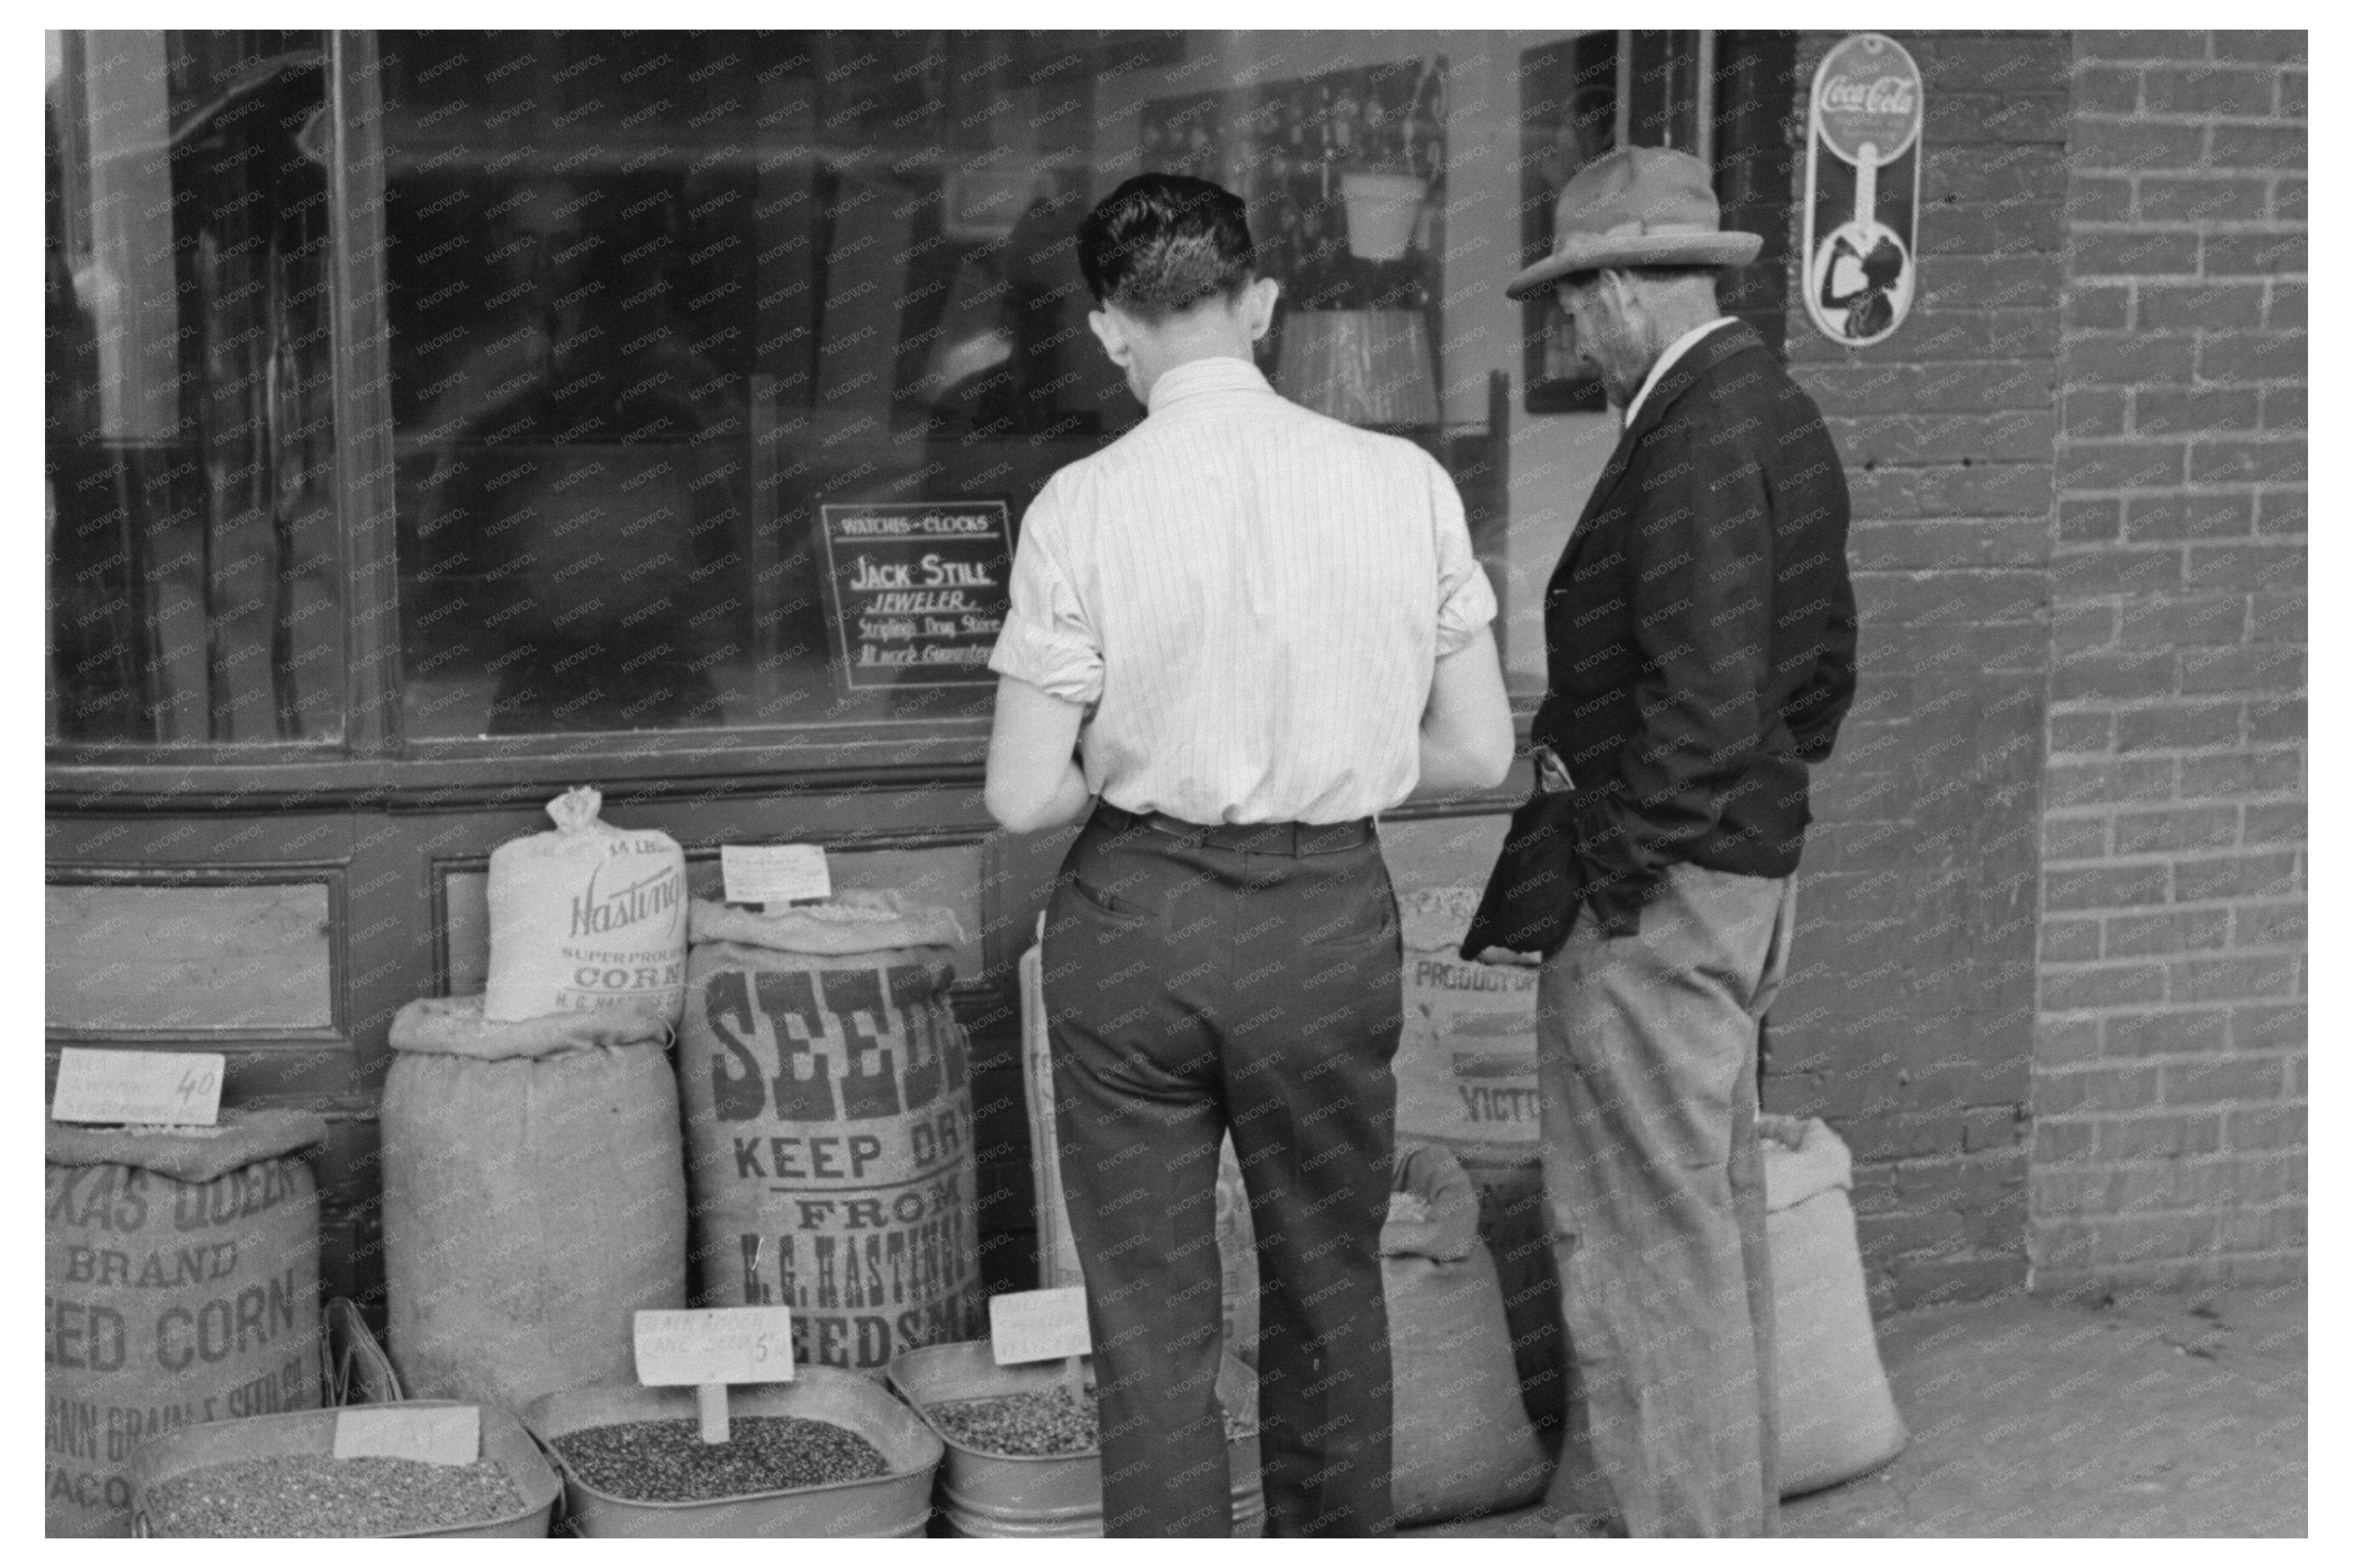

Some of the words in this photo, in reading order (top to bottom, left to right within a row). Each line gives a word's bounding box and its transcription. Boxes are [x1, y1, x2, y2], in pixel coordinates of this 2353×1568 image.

[962, 615, 1001, 632] Store
[574, 963, 680, 989] CORN
[1416, 960, 1507, 992] PRODUCT
[733, 1135, 881, 1178] KEEP
[171, 1159, 296, 1231] QUEEN
[795, 1173, 963, 1230] FROM
[65, 1241, 239, 1288] BRAND
[156, 1268, 294, 1373] CORN
[46, 1464, 133, 1510] ACO
